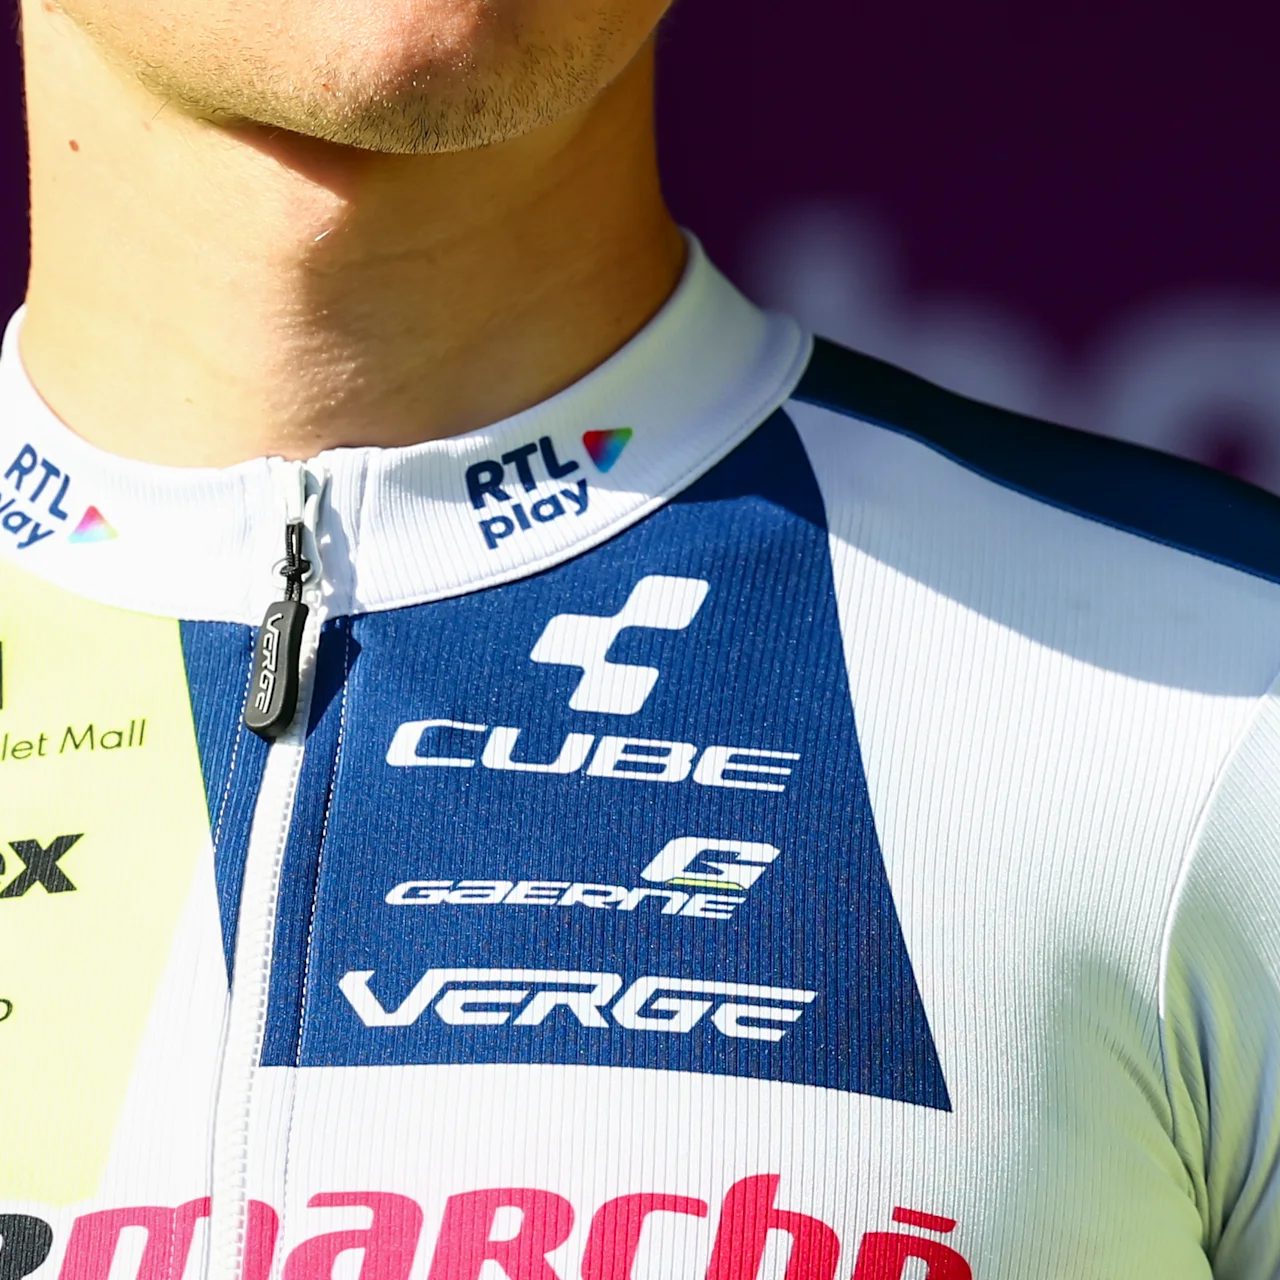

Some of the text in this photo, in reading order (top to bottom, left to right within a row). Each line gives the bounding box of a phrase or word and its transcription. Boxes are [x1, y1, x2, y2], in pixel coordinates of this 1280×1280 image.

[5, 444, 70, 521] RTL
[465, 435, 580, 510] RTL
[479, 478, 588, 550] play
[59, 718, 146, 754] Mall
[386, 719, 800, 791] CUBE
[338, 967, 817, 1042] VERGE
